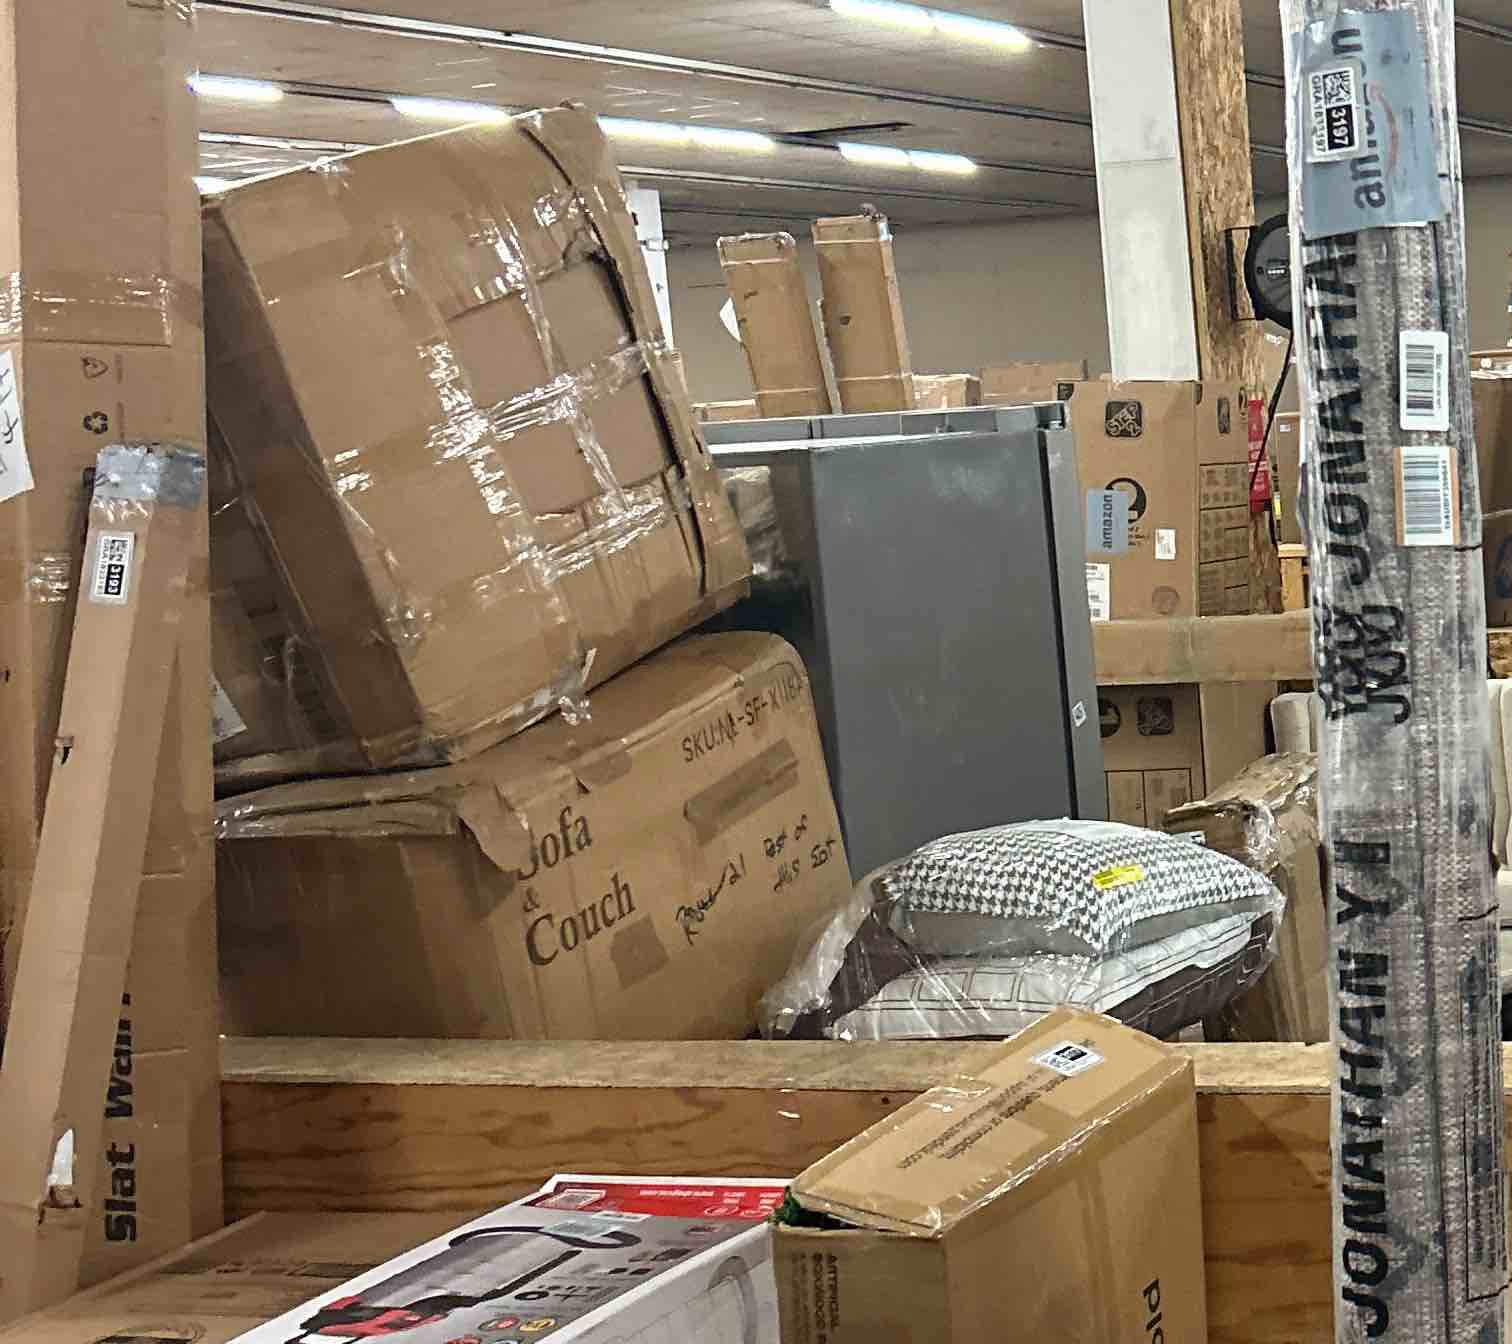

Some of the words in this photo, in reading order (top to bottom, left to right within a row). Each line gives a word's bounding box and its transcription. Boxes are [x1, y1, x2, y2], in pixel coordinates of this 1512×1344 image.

[1329, 105, 1352, 151] 3197
[1102, 494, 1114, 549] amazon
[108, 565, 122, 595] 3193
[522, 886, 541, 913] &
[525, 871, 637, 967] Couch
[103, 1141, 137, 1243] Slat
